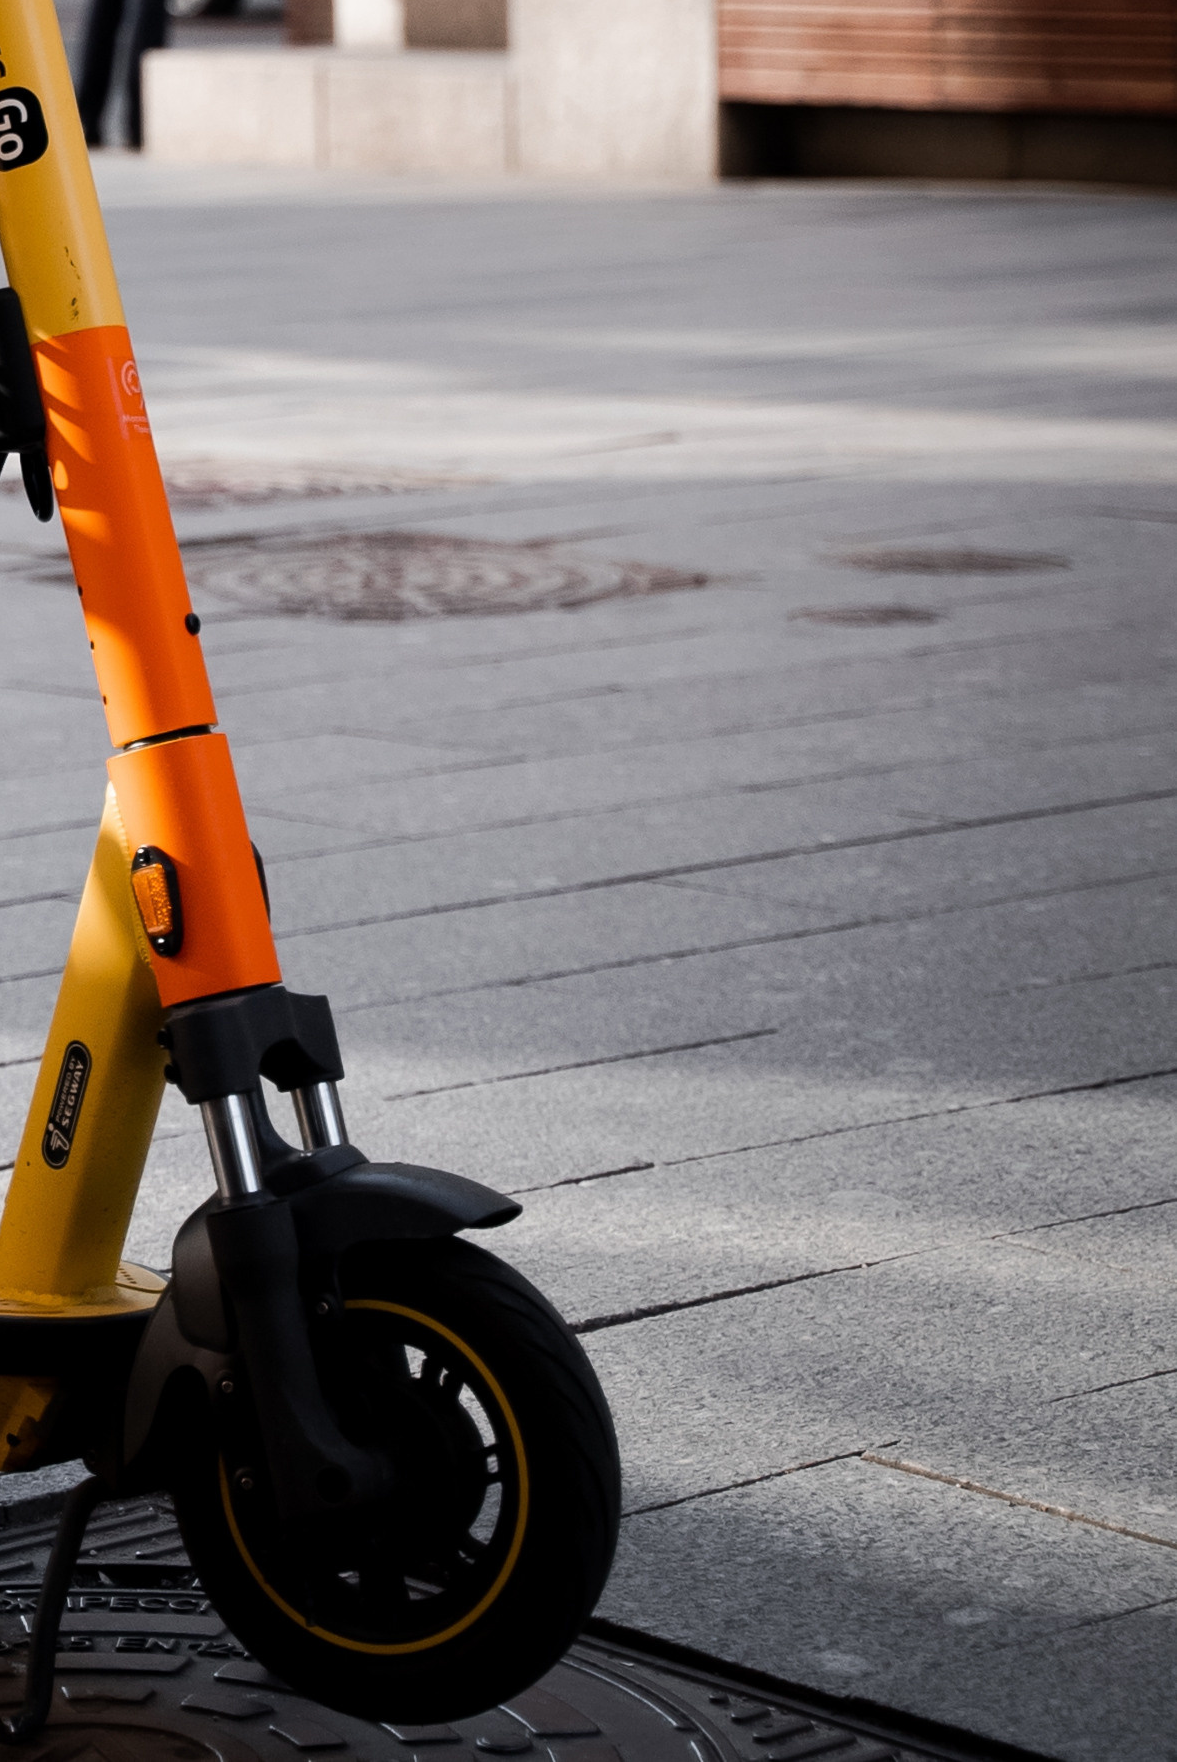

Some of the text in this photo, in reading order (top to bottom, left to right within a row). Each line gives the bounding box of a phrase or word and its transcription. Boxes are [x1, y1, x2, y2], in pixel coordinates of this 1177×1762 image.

[55, 1055, 75, 1123] POWERED BY
[61, 1060, 84, 1128] SEGWAY
[115, 1636, 177, 1652] EN
